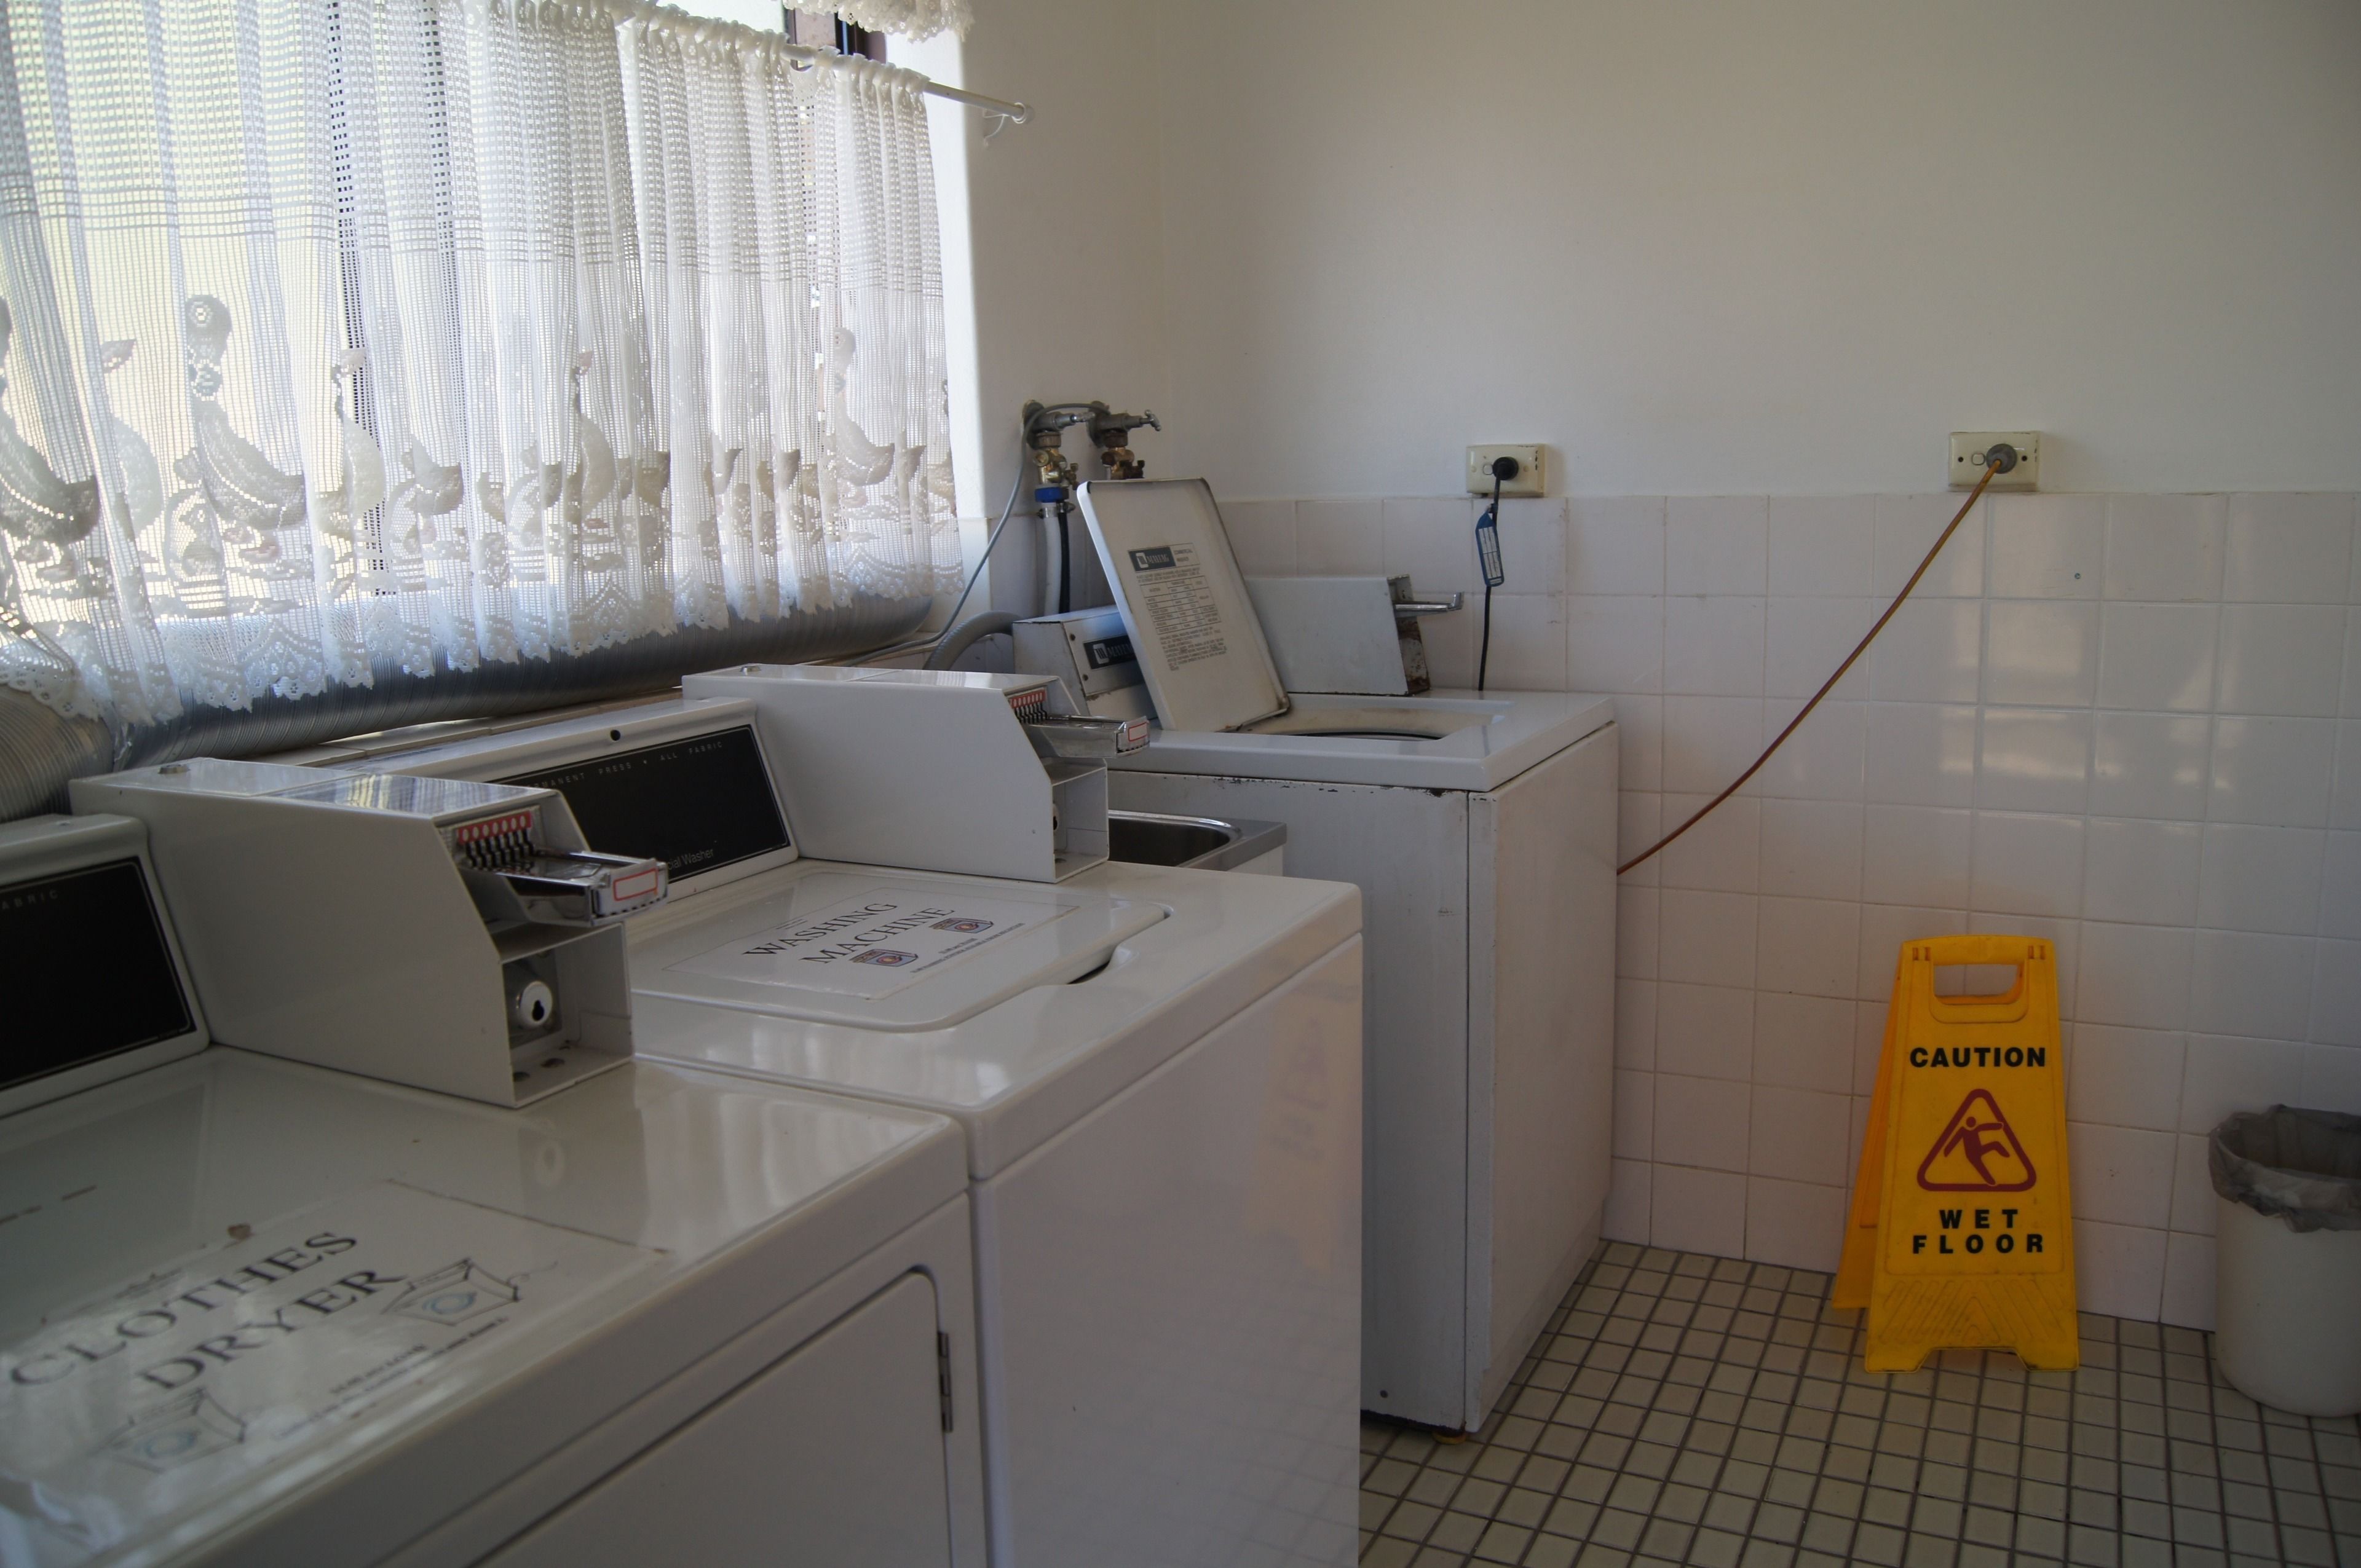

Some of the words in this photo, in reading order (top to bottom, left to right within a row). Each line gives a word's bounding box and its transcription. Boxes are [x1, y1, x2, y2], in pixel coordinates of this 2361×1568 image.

[598, 762, 633, 776] PRESS
[659, 751, 679, 762] ALL
[688, 741, 724, 755] FABRIC
[681, 848, 714, 867] Washer
[0, 889, 59, 911] ABRIC
[742, 902, 899, 956] WASHING
[799, 907, 955, 964] MACHINE
[1909, 1046, 2047, 1069] CAUTION
[1938, 1208, 2019, 1230] WET
[1912, 1233, 2044, 1255] FLOOR
[10, 1231, 358, 1387] CLOTHES
[138, 1268, 408, 1390] DRYER
